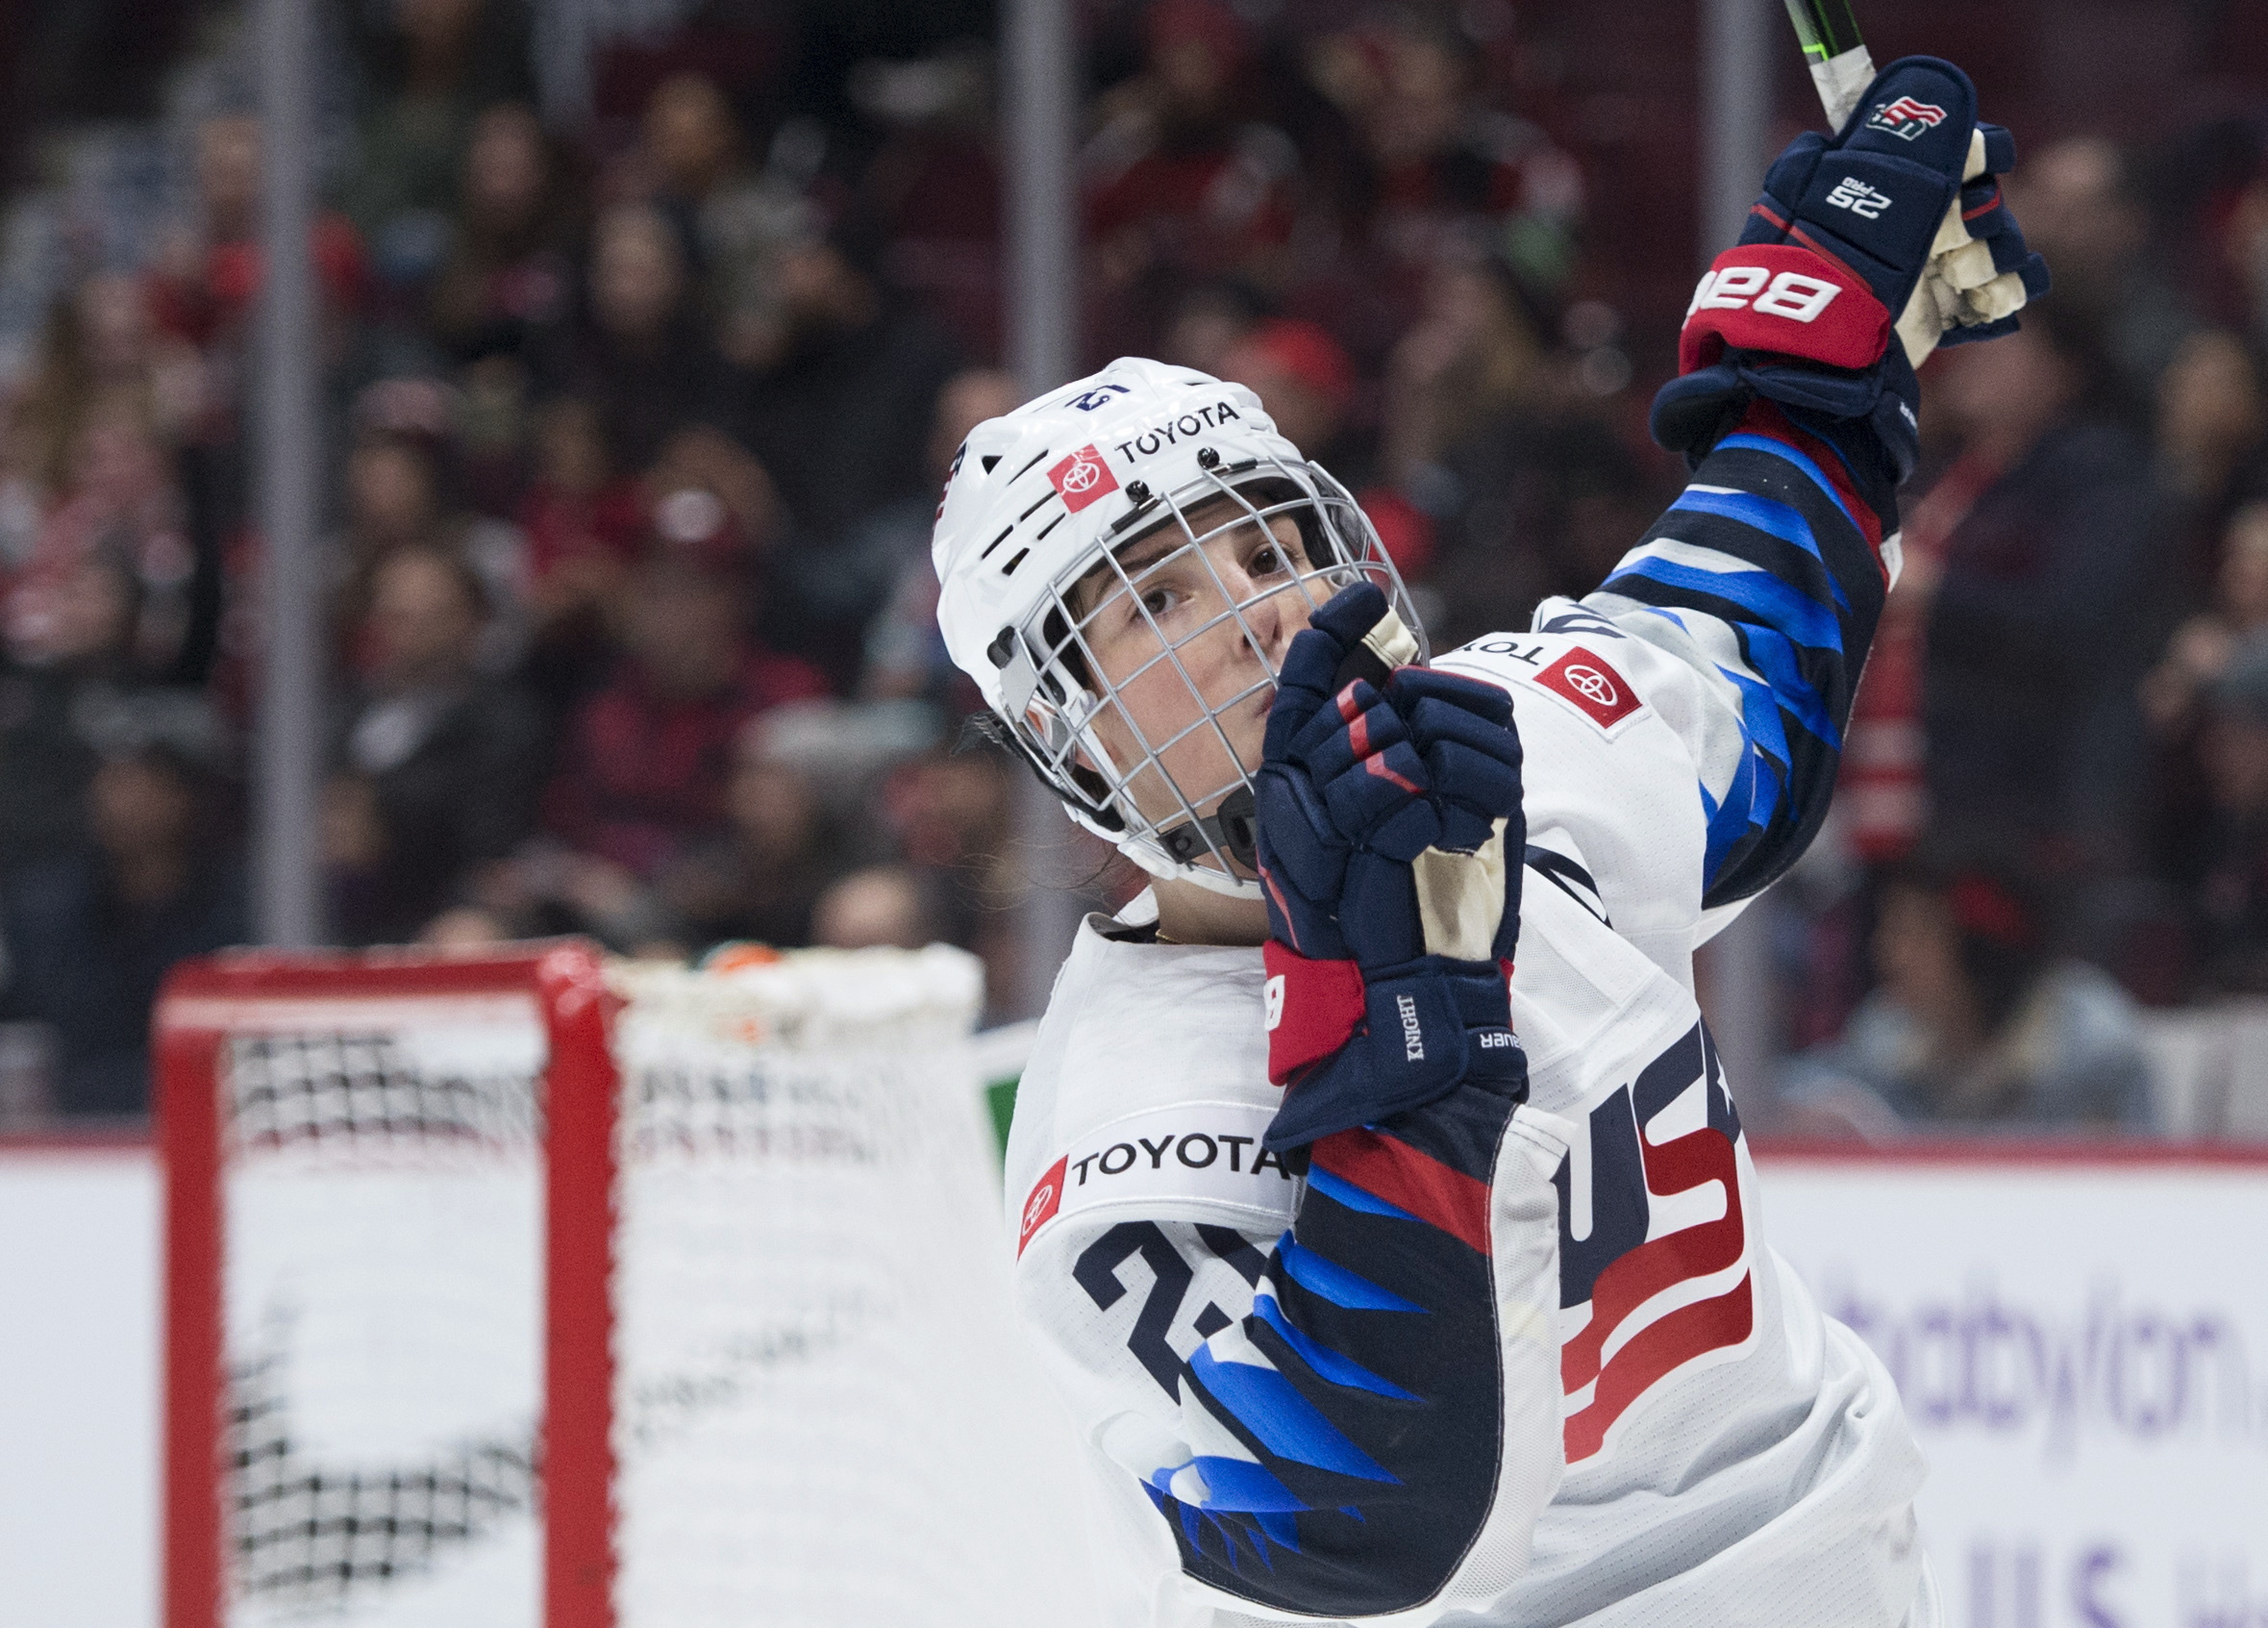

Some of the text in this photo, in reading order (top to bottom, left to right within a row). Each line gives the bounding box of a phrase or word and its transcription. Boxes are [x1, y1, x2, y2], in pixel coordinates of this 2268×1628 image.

[1114, 402, 1240, 464] TOYOTA
[1397, 994, 1425, 1063] KNIGHT
[1071, 1133, 1291, 1187] TOYOTA
